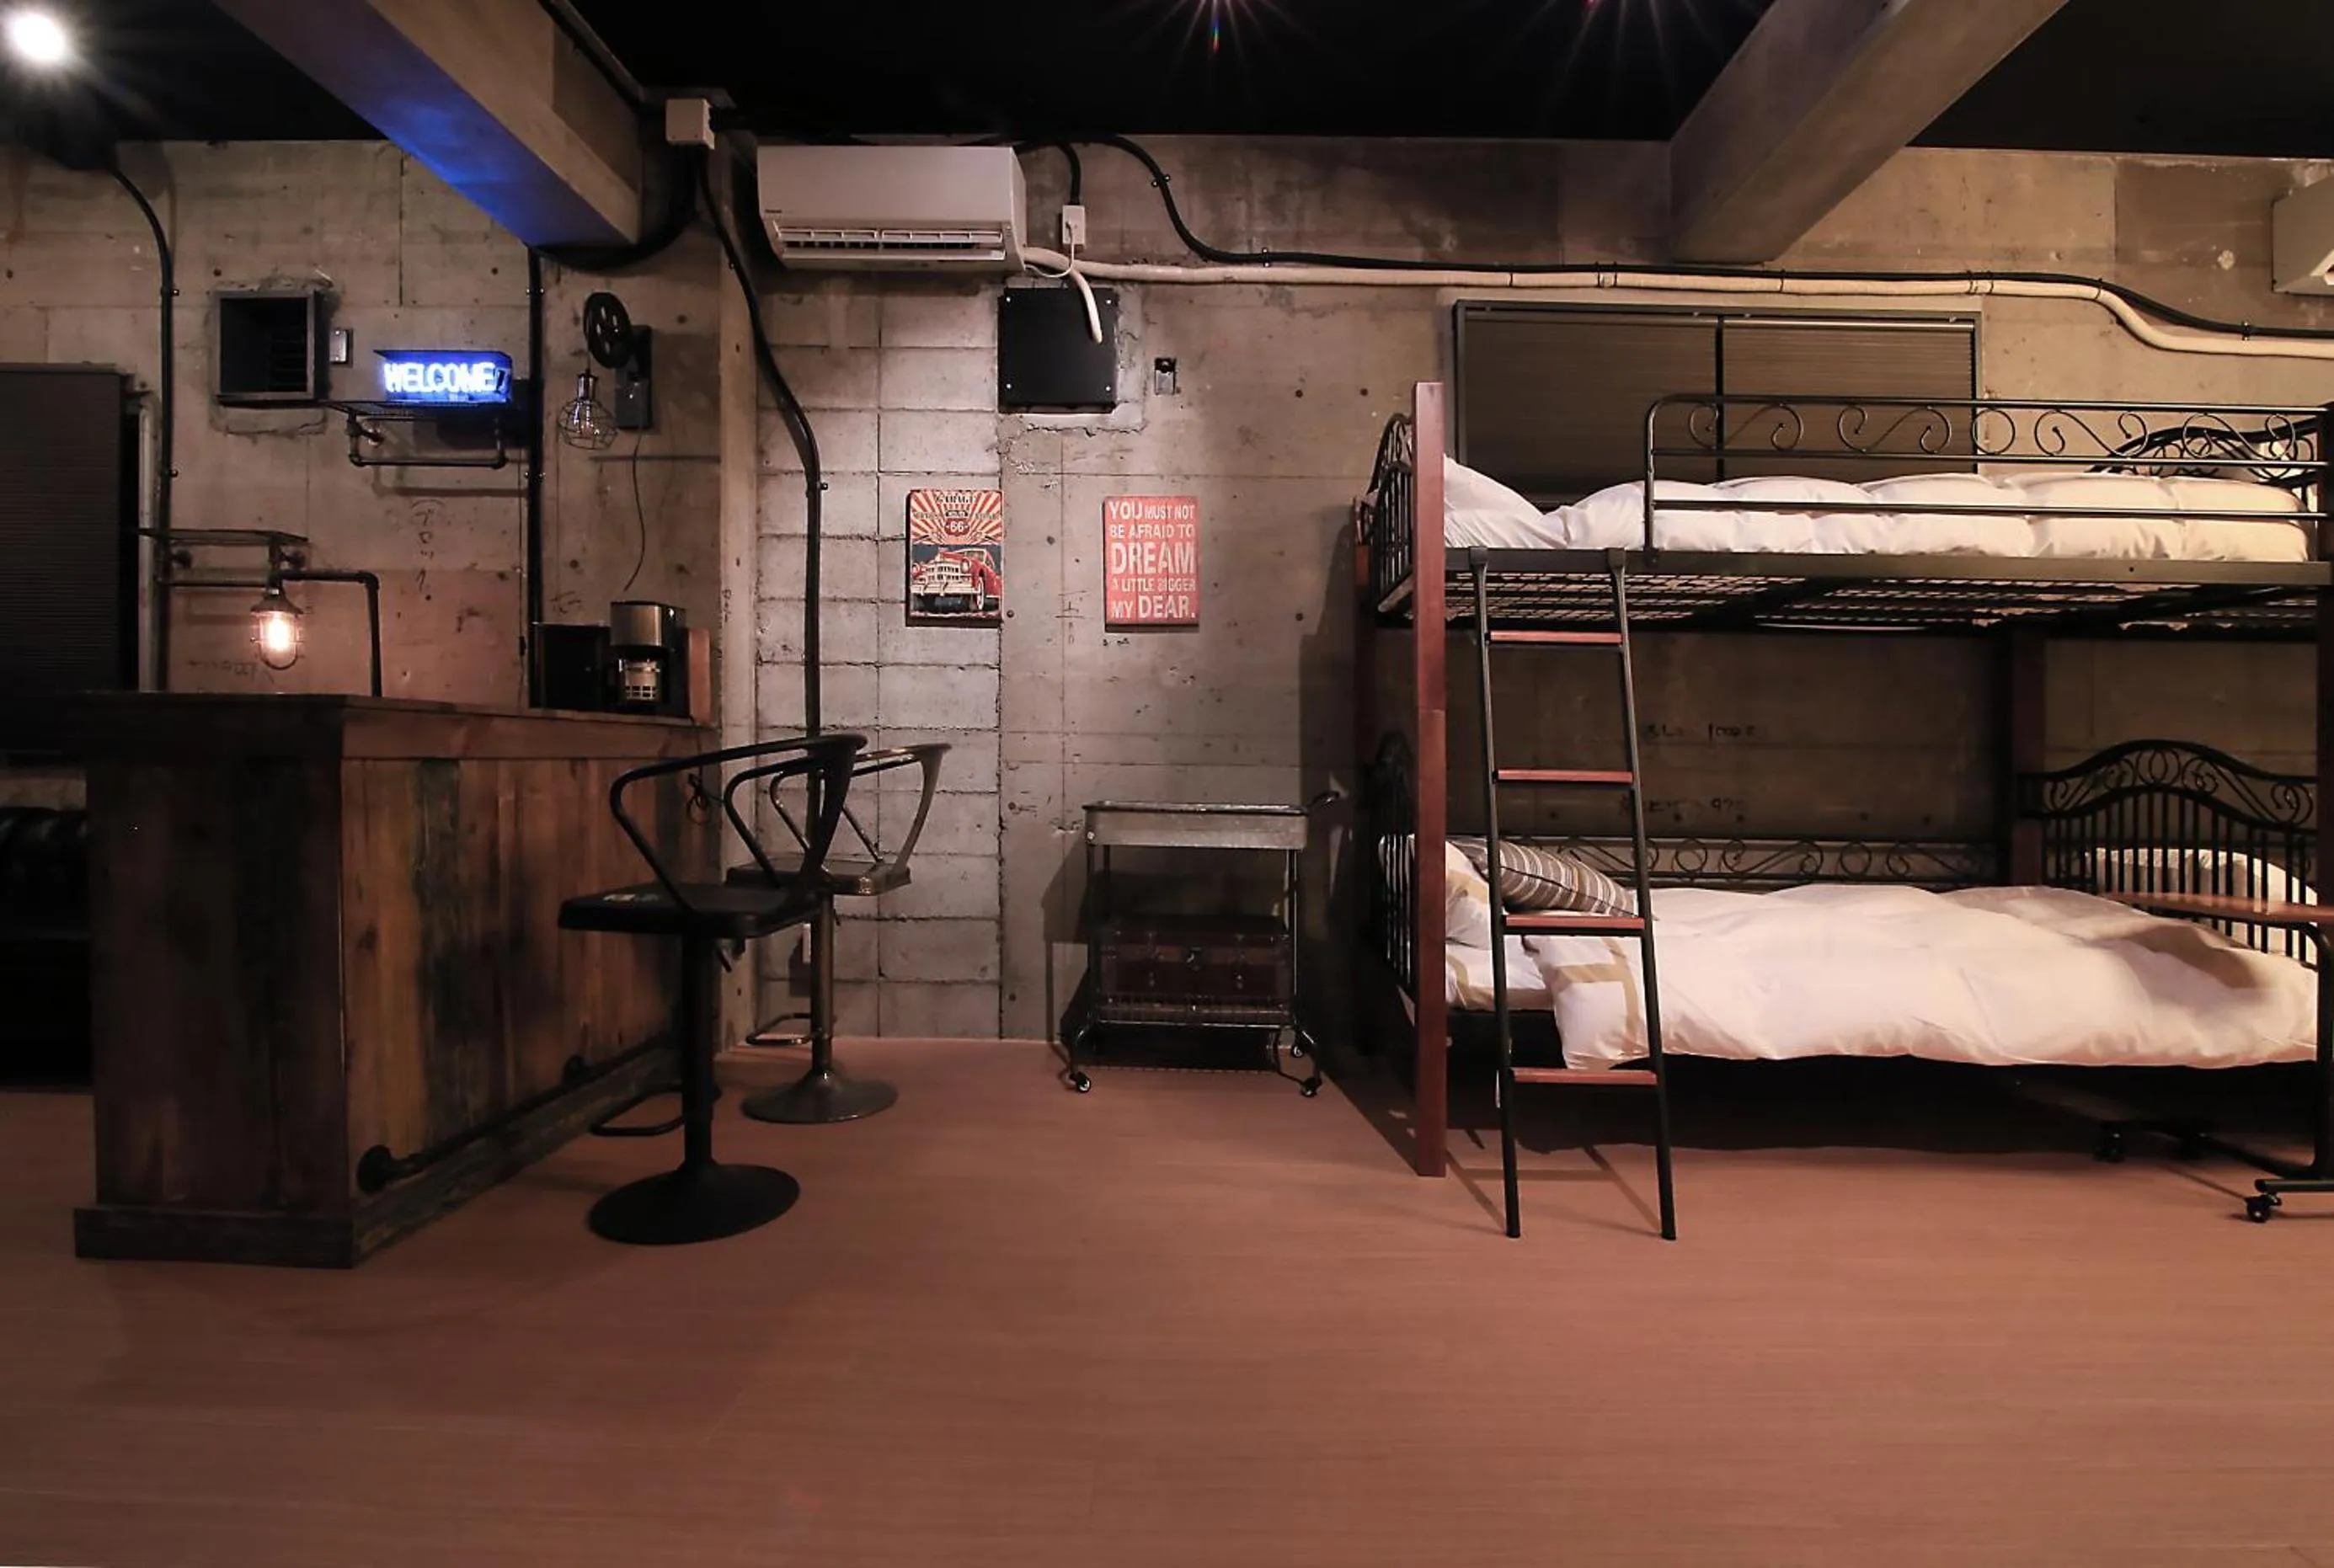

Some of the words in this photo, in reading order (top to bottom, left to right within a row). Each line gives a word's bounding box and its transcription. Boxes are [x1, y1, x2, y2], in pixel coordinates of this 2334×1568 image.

[383, 361, 496, 392] WELCOME
[1108, 500, 1143, 520] YOU
[1145, 505, 1172, 520] MUST
[1174, 504, 1195, 520] NOT
[950, 520, 964, 533] 66
[1110, 524, 1125, 538] BE
[1128, 524, 1175, 539] AFRAID
[1179, 524, 1195, 539] TO
[1111, 541, 1195, 574] DREAM
[1121, 578, 1155, 592] LITTLE
[1111, 600, 1134, 618] MY
